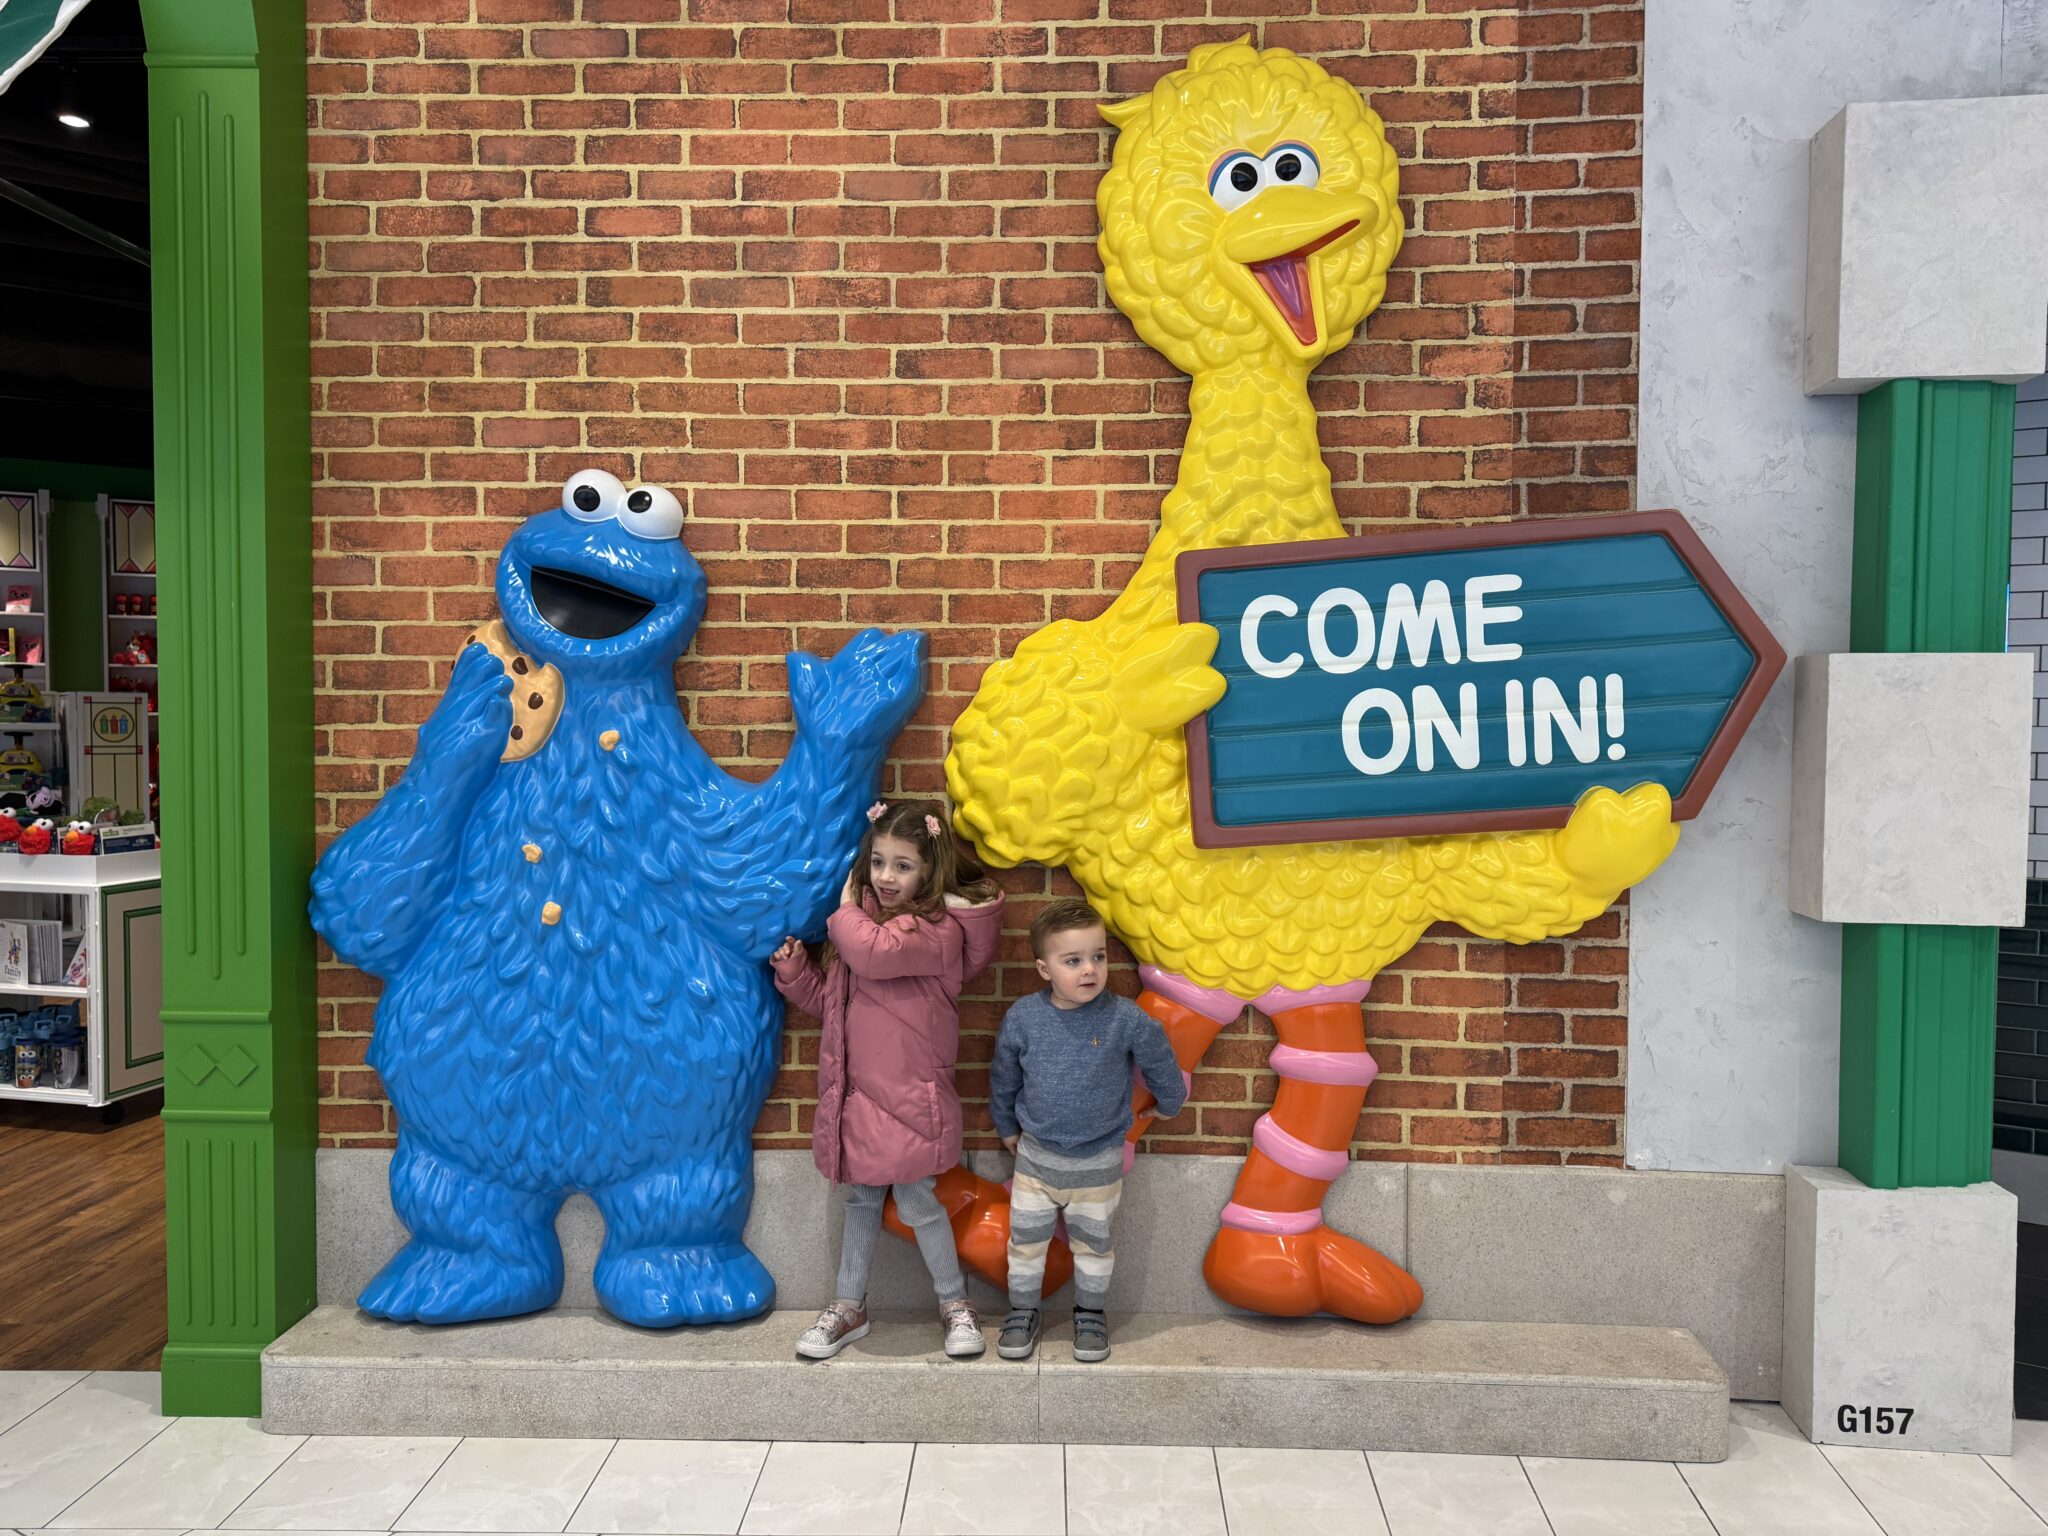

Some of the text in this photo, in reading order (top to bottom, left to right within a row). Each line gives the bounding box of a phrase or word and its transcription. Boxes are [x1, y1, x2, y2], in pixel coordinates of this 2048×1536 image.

[1239, 573, 1524, 679] COME
[1340, 672, 1627, 776] ON IN!
[1837, 1404, 1915, 1435] G157
